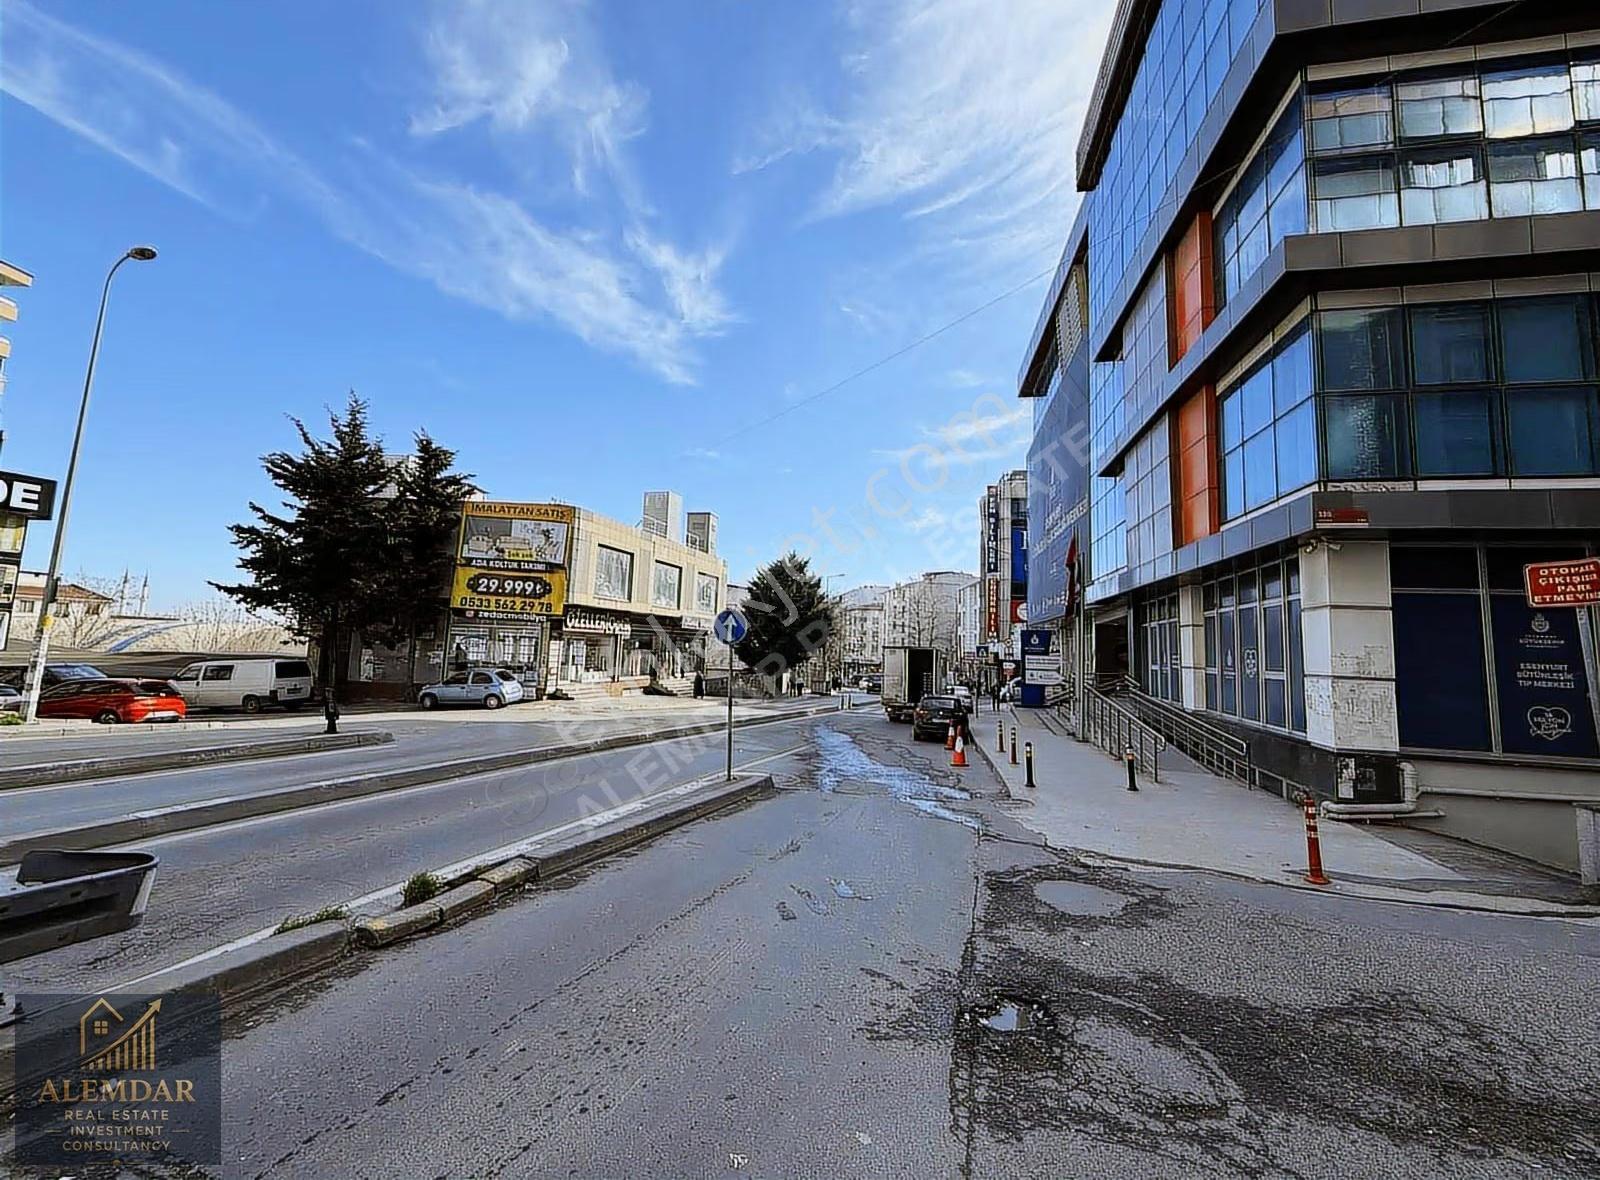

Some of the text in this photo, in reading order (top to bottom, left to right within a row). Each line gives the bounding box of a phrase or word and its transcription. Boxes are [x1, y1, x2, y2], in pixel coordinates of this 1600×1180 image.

[460, 597, 553, 613] 0533 562 29 78
